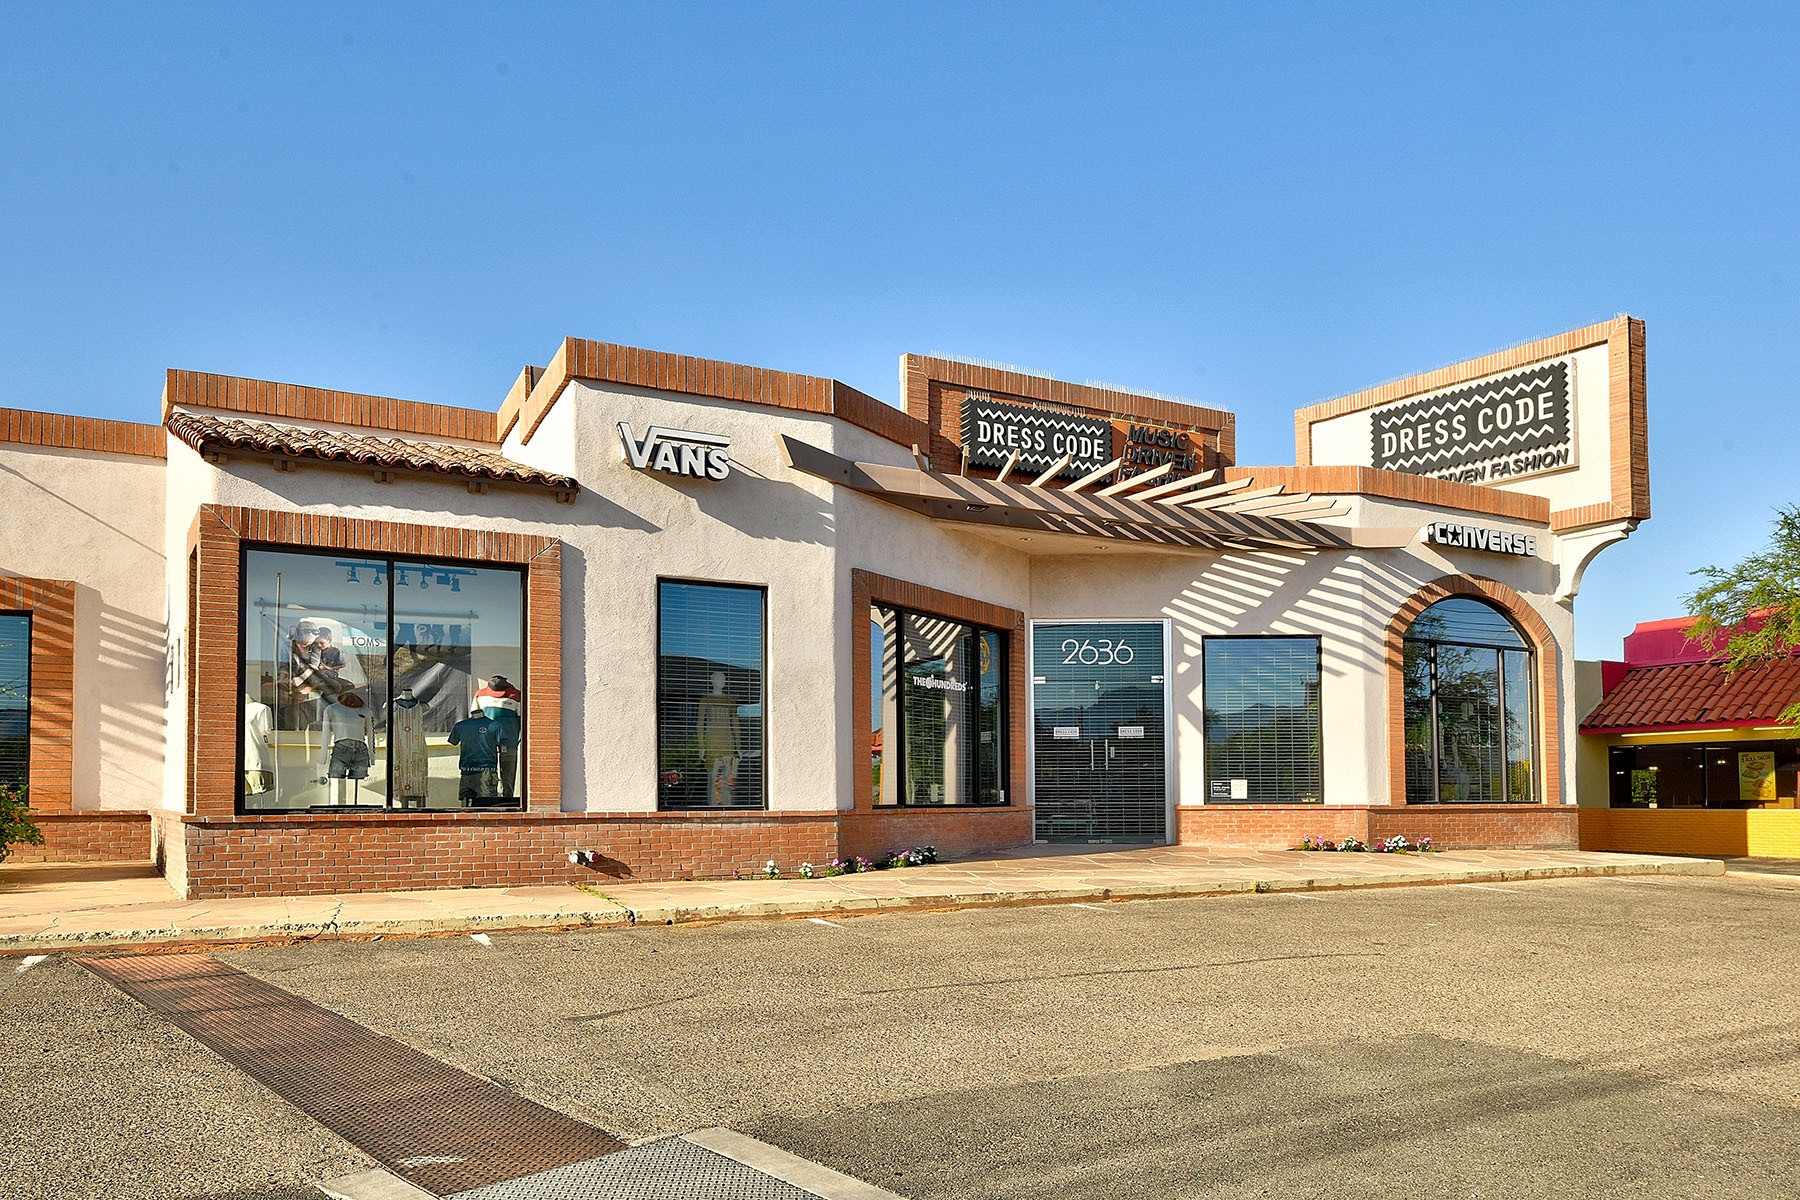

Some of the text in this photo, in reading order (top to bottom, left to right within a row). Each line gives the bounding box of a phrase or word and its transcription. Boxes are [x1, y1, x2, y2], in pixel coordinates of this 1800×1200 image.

[1126, 424, 1190, 450] MUSIC
[1380, 391, 1554, 458] DRESS CODE
[616, 421, 731, 481] VANS
[977, 420, 1104, 461] DRESS CODE
[1122, 443, 1197, 472] DRIVEN
[1489, 448, 1569, 481] FASHION
[1433, 521, 1538, 557] CONVERSE
[350, 636, 380, 647] TOMS
[1061, 638, 1134, 665] 2636
[912, 675, 926, 687] THE
